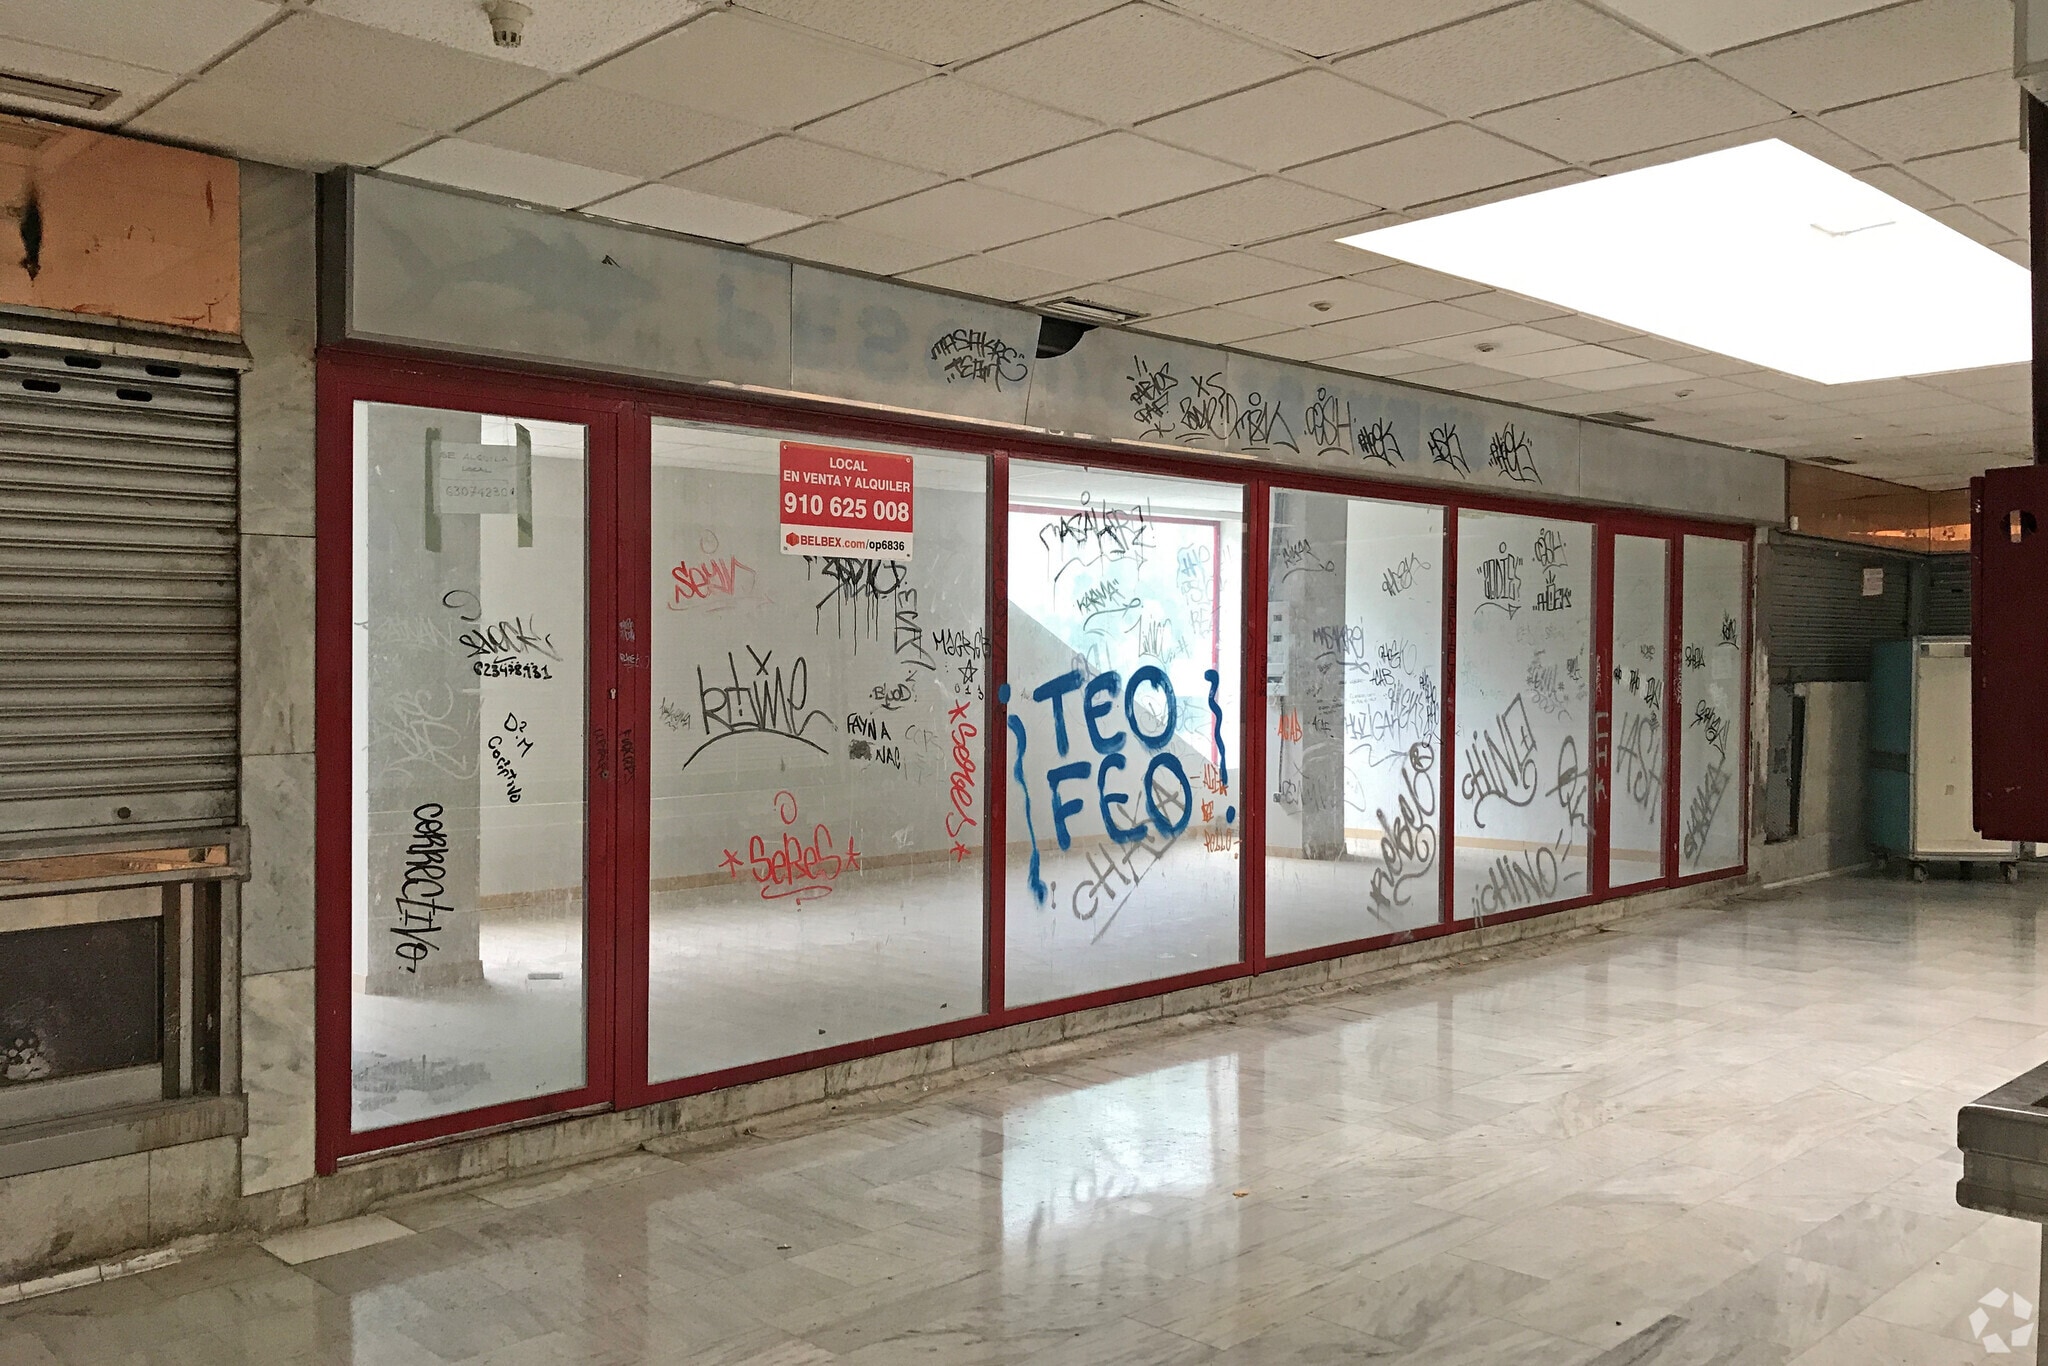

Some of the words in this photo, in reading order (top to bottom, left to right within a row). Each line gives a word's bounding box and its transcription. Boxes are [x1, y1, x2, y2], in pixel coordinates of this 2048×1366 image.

[829, 457, 868, 472] LOCAL
[783, 469, 800, 482] EN
[803, 471, 842, 487] VENTA
[844, 476, 852, 487] Y
[854, 478, 911, 493] ALQUILER
[784, 492, 823, 516] 910
[829, 496, 867, 519] 625
[873, 500, 910, 522] 008
[800, 534, 905, 552] BELBEX.com/op6836
